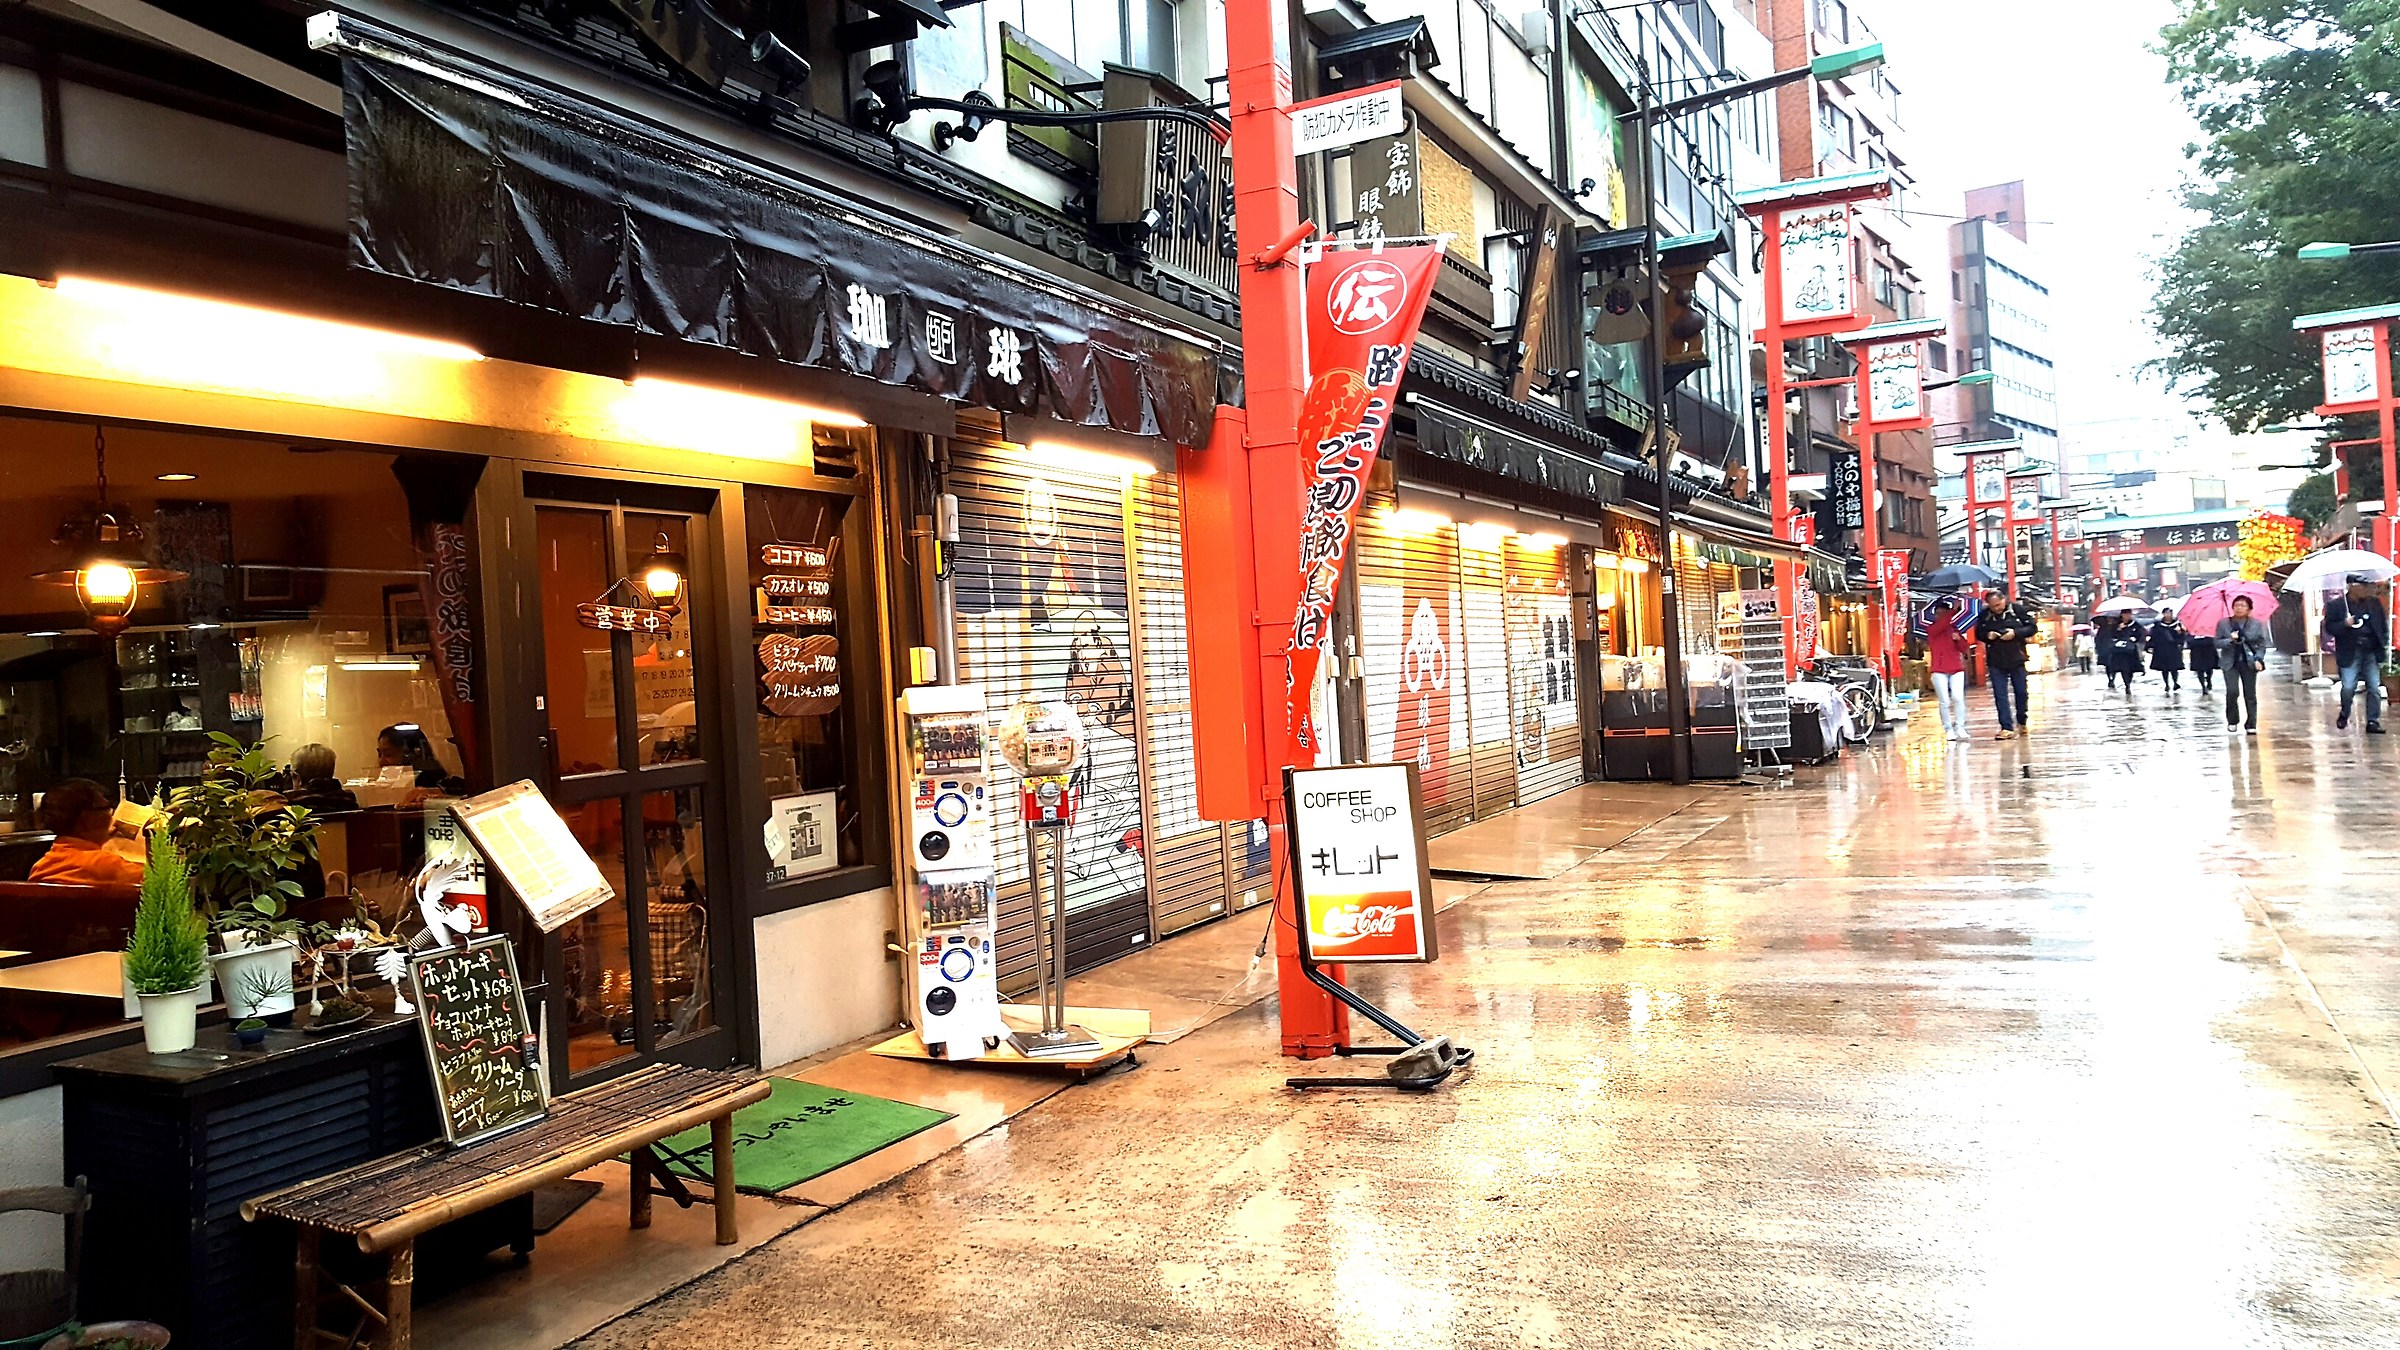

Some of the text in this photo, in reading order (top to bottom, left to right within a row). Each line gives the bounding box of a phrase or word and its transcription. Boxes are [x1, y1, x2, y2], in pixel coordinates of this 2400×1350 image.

[1302, 96, 1390, 141] 防犯カメラ作動中
[1386, 141, 1413, 198] 宝飾
[1358, 186, 1385, 240] 眼鏡
[1332, 268, 1396, 326] 伝
[1834, 461, 1845, 526] YONOYA COMB
[770, 549, 826, 566] ココア ¥600
[2015, 525, 2032, 566] 大黒家
[770, 578, 830, 596] カフェオレ ¥500
[594, 605, 661, 633] 営業中
[773, 608, 833, 623] コーヒー ¥450
[773, 643, 800, 659] ピラフ
[814, 654, 837, 673] ¥700
[1304, 790, 1373, 809] COFFEE
[1350, 806, 1397, 824] SHOP
[1311, 845, 1399, 876] キレット
[766, 869, 785, 883] 37-12
[423, 952, 491, 987] ホットケーキ
[441, 977, 480, 1003] セット
[434, 1003, 492, 1031] チョコバナナ
[450, 1013, 513, 1041] ホットケーキセット
[440, 1052, 466, 1076] ピラフ
[471, 1056, 513, 1083] クリーム
[494, 1066, 526, 1092] ソーダ
[453, 1096, 486, 1129] ココア
